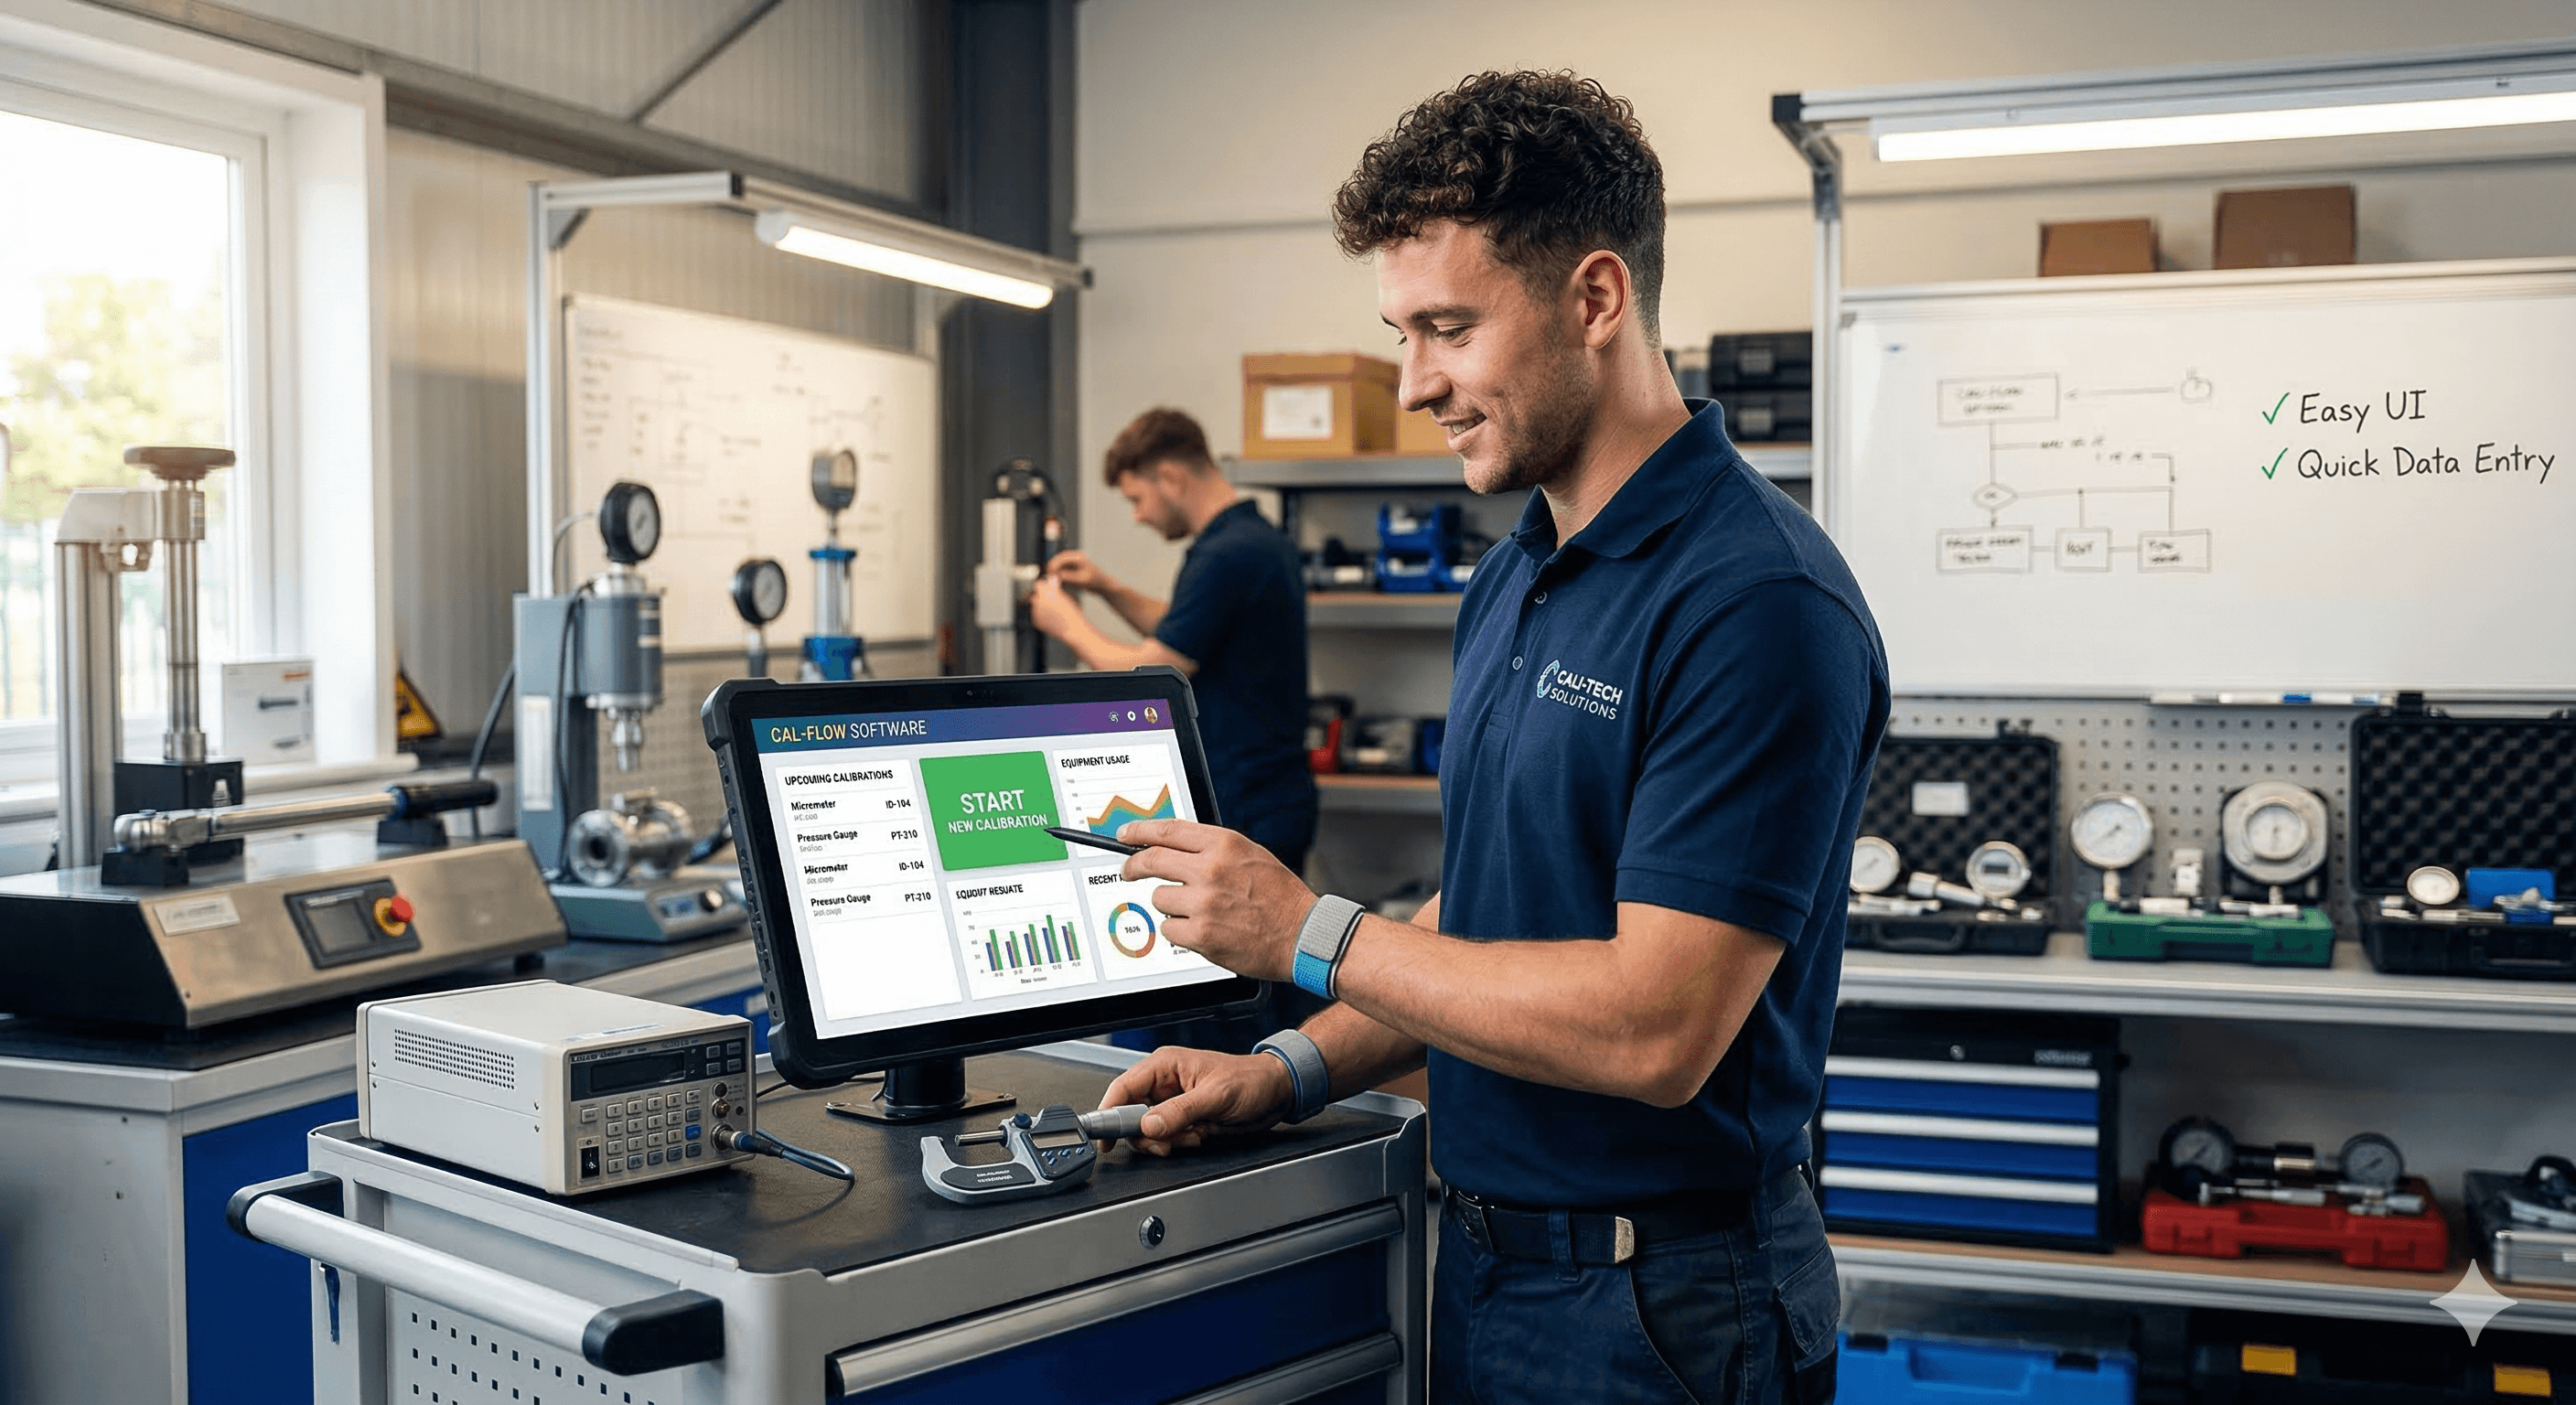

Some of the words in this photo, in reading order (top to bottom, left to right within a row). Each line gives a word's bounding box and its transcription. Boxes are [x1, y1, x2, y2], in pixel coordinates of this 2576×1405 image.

[2300, 392, 2370, 434] Easy
[2386, 390, 2427, 421] UI
[2297, 448, 2380, 479] Quick
[2392, 446, 2461, 477] Data
[2474, 442, 2556, 485] Entry
[1550, 688, 1617, 720] SOLUTIONS
[770, 724, 846, 743] CAL-FLOW
[850, 720, 928, 739] SOFTWARE
[1060, 756, 1104, 769] EQUIPMENT
[885, 799, 911, 810] ID-104
[961, 789, 1025, 814] START
[948, 820, 973, 833] NEW
[975, 813, 1048, 831] CALIBRATION
[832, 831, 858, 841] Gauge
